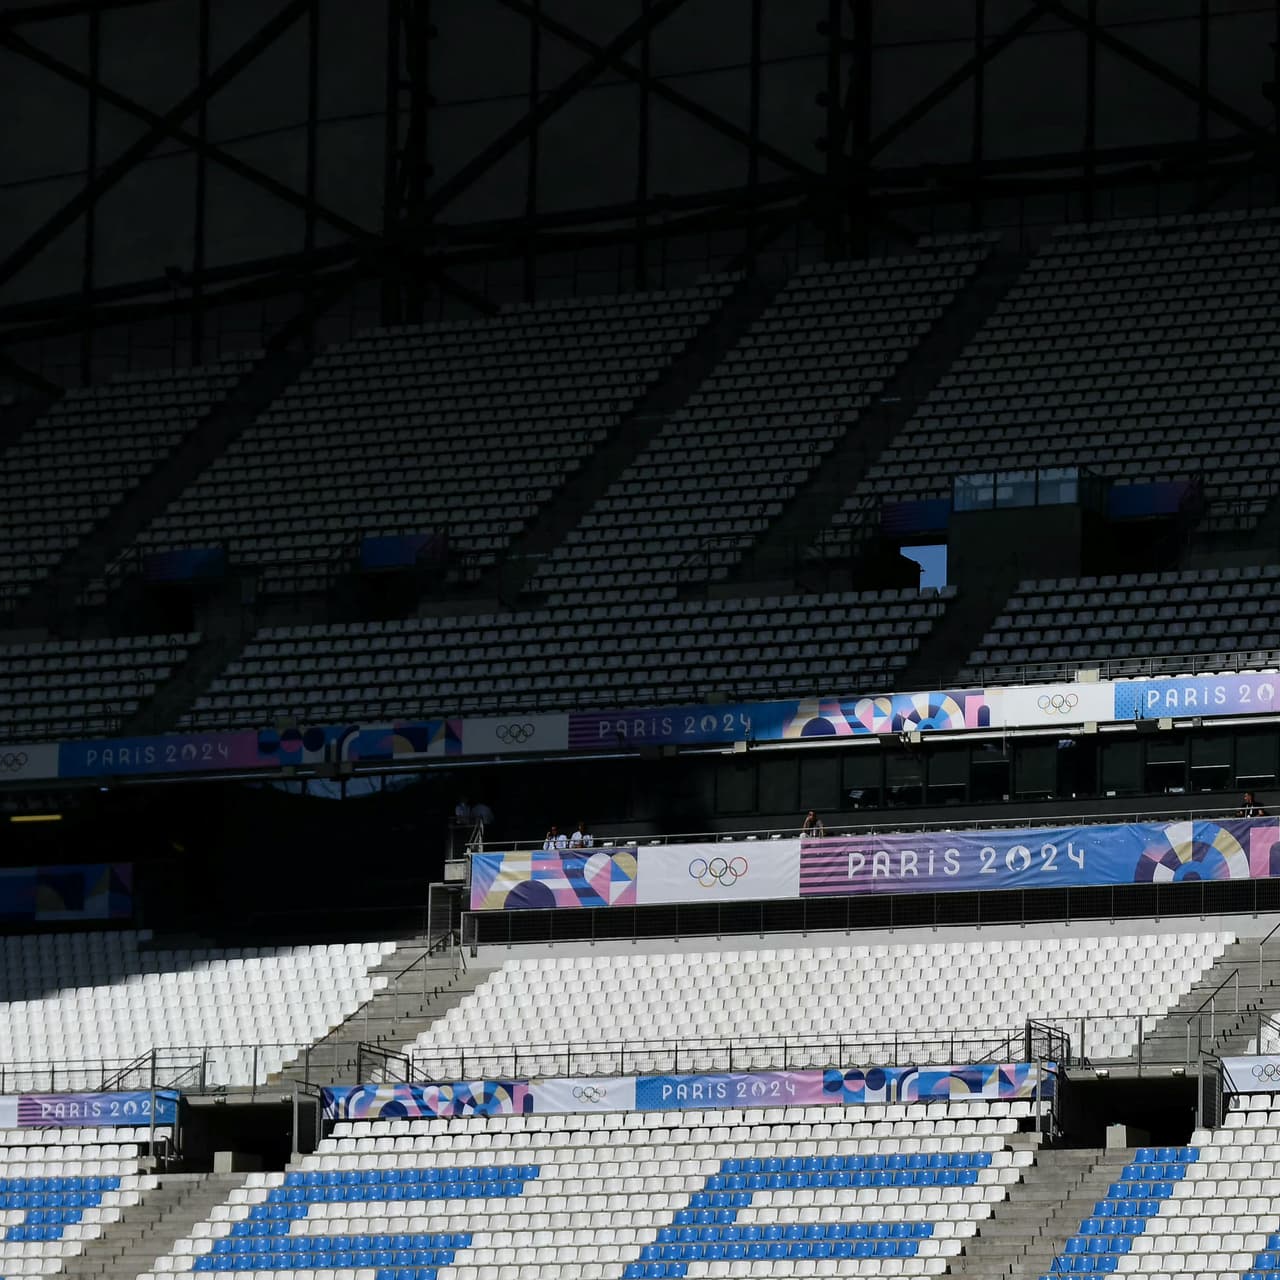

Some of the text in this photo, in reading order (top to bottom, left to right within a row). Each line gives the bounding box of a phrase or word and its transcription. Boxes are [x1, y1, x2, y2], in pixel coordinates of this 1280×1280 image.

[1147, 685, 1226, 708] PARIS
[598, 712, 751, 738] PARIS 2024
[86, 742, 230, 767] PARIS 2024
[847, 842, 1085, 879] PARIS 2024
[662, 1080, 796, 1100] PARIS 2024
[41, 1099, 164, 1118] PARIS 2024
